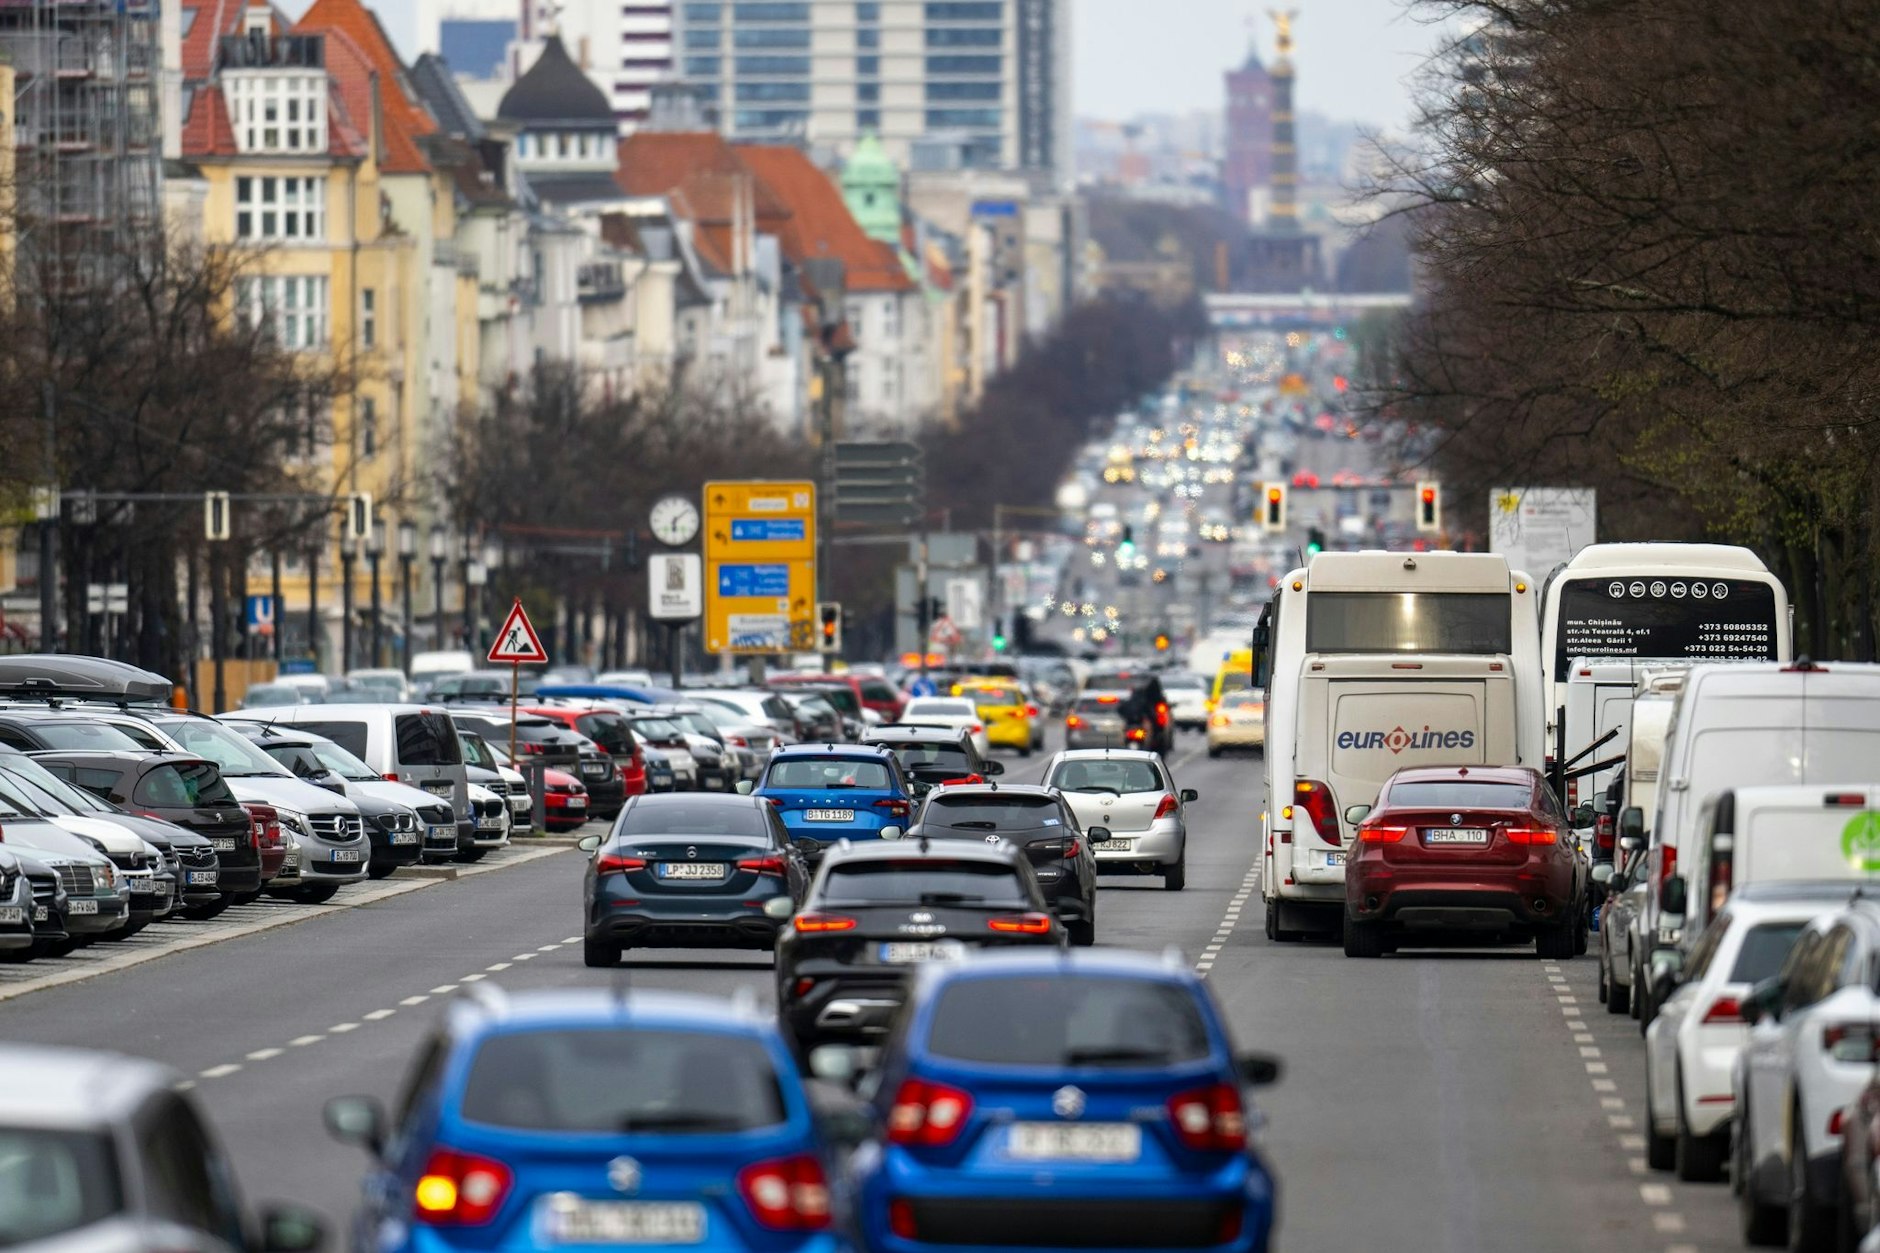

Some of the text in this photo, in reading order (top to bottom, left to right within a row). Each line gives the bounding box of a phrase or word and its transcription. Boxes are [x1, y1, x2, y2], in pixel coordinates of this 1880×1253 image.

[808, 810, 853, 819] B TG 1189
[1433, 831, 1482, 840] BHA 110
[1100, 840, 1127, 848] RJ 822
[665, 864, 723, 875] LP JJ 2358
